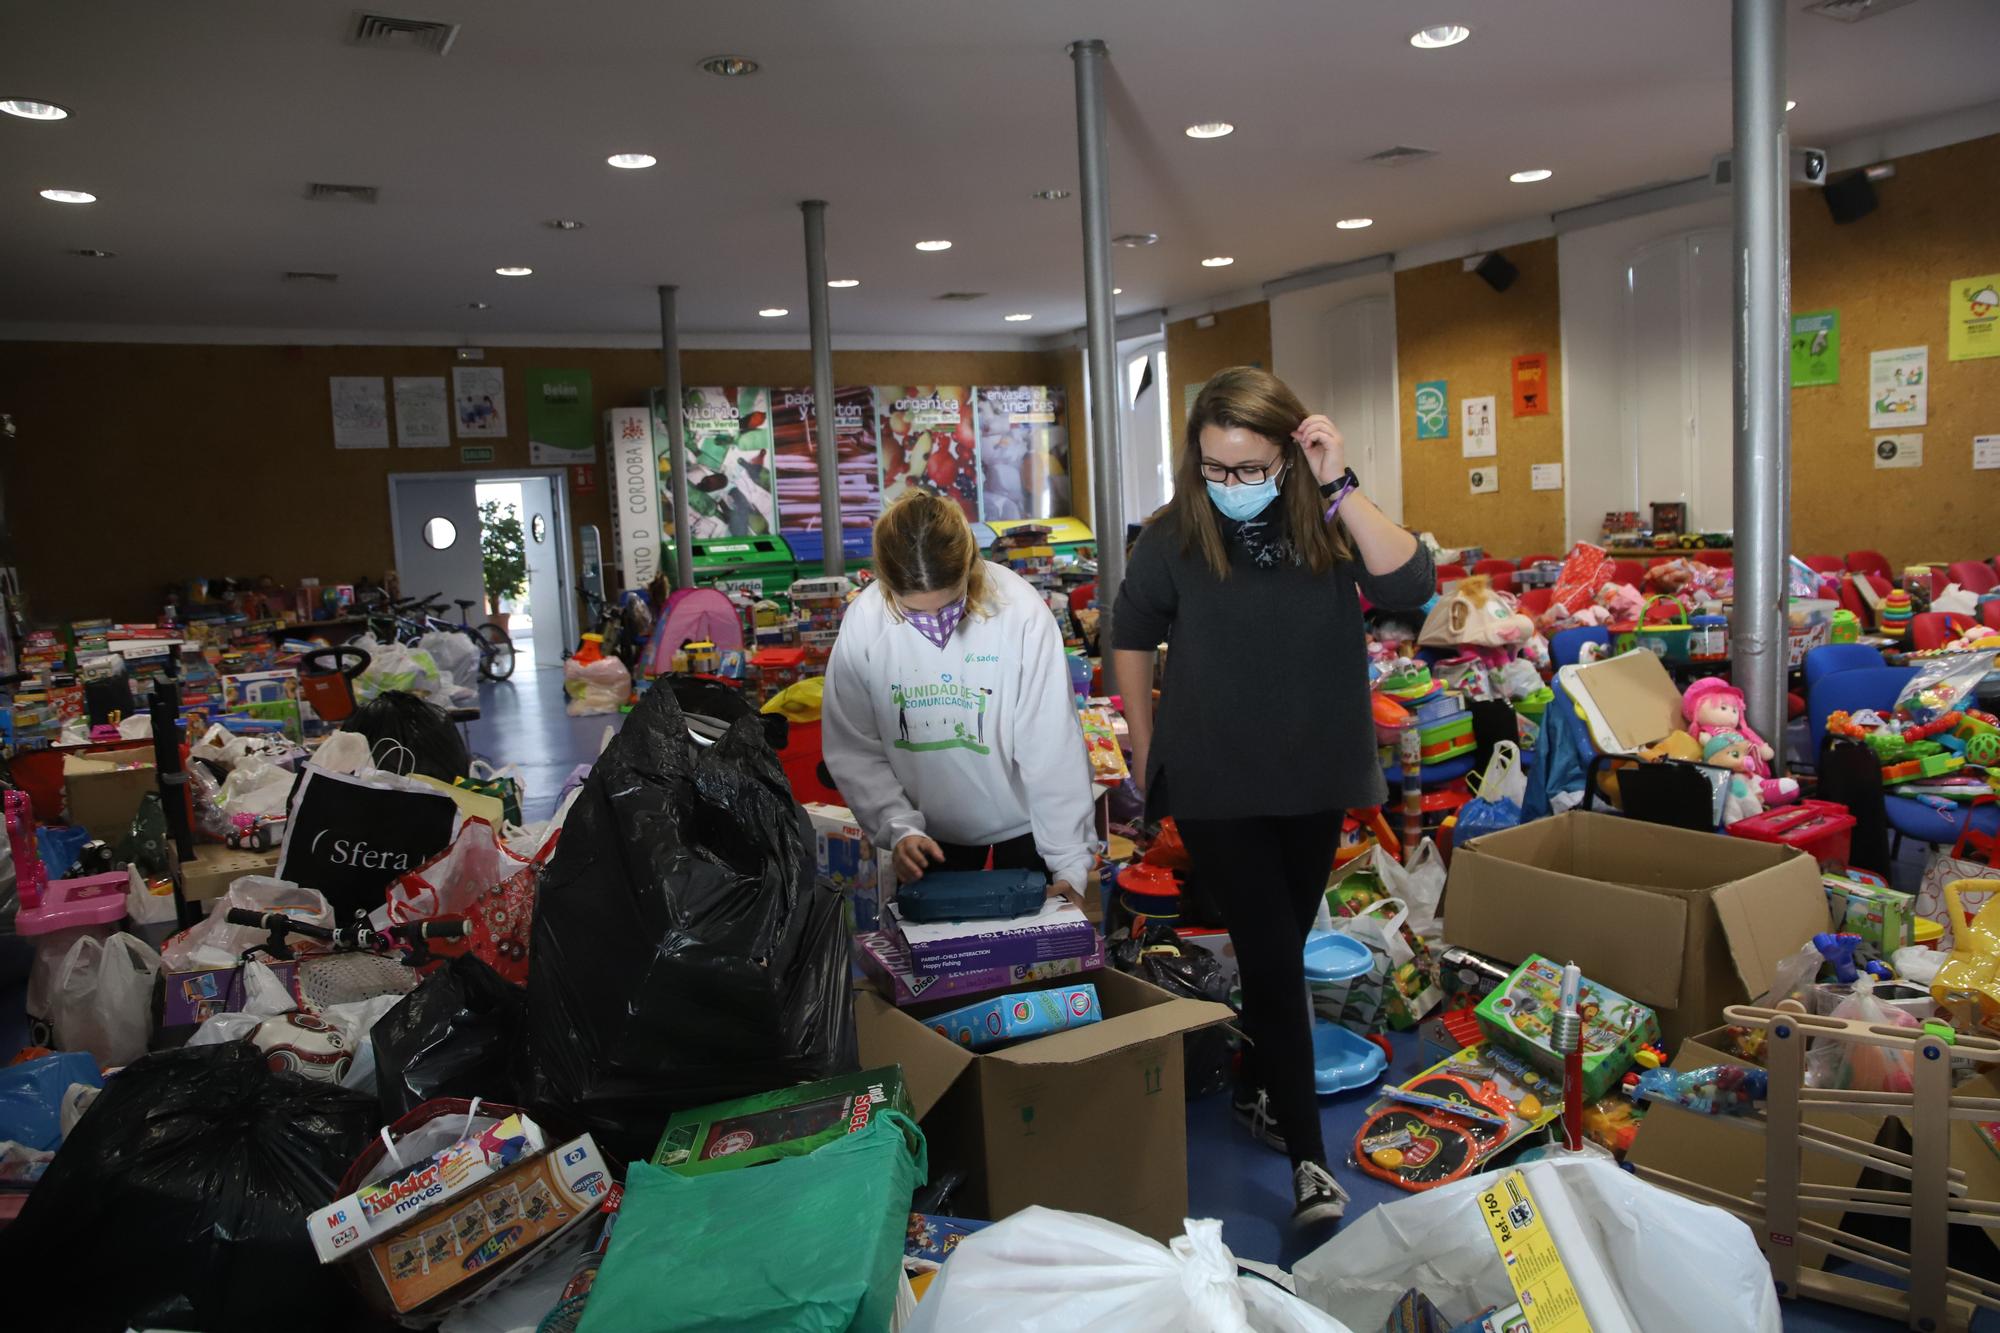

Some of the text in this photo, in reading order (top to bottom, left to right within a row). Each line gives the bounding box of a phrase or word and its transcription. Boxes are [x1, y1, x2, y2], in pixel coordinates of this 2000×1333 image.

[987, 391, 1031, 401] envases
[1003, 400, 1055, 413] inertes
[682, 405, 740, 420] vidrio
[629, 447, 648, 514] CORDOBA
[633, 548, 652, 587] ENTO
[726, 582, 762, 592] Vidrio
[904, 684, 959, 699] UNIDAD
[329, 839, 410, 871] Sfera
[867, 1082, 889, 1104] Total
[848, 1093, 873, 1134] SOCC
[364, 1165, 439, 1216] Twister
[571, 1173, 603, 1193] creation
[587, 1180, 608, 1198] MB
[395, 1182, 443, 1215] moves
[326, 1210, 347, 1229] MB
[1484, 1193, 1513, 1243] Ref. 760
